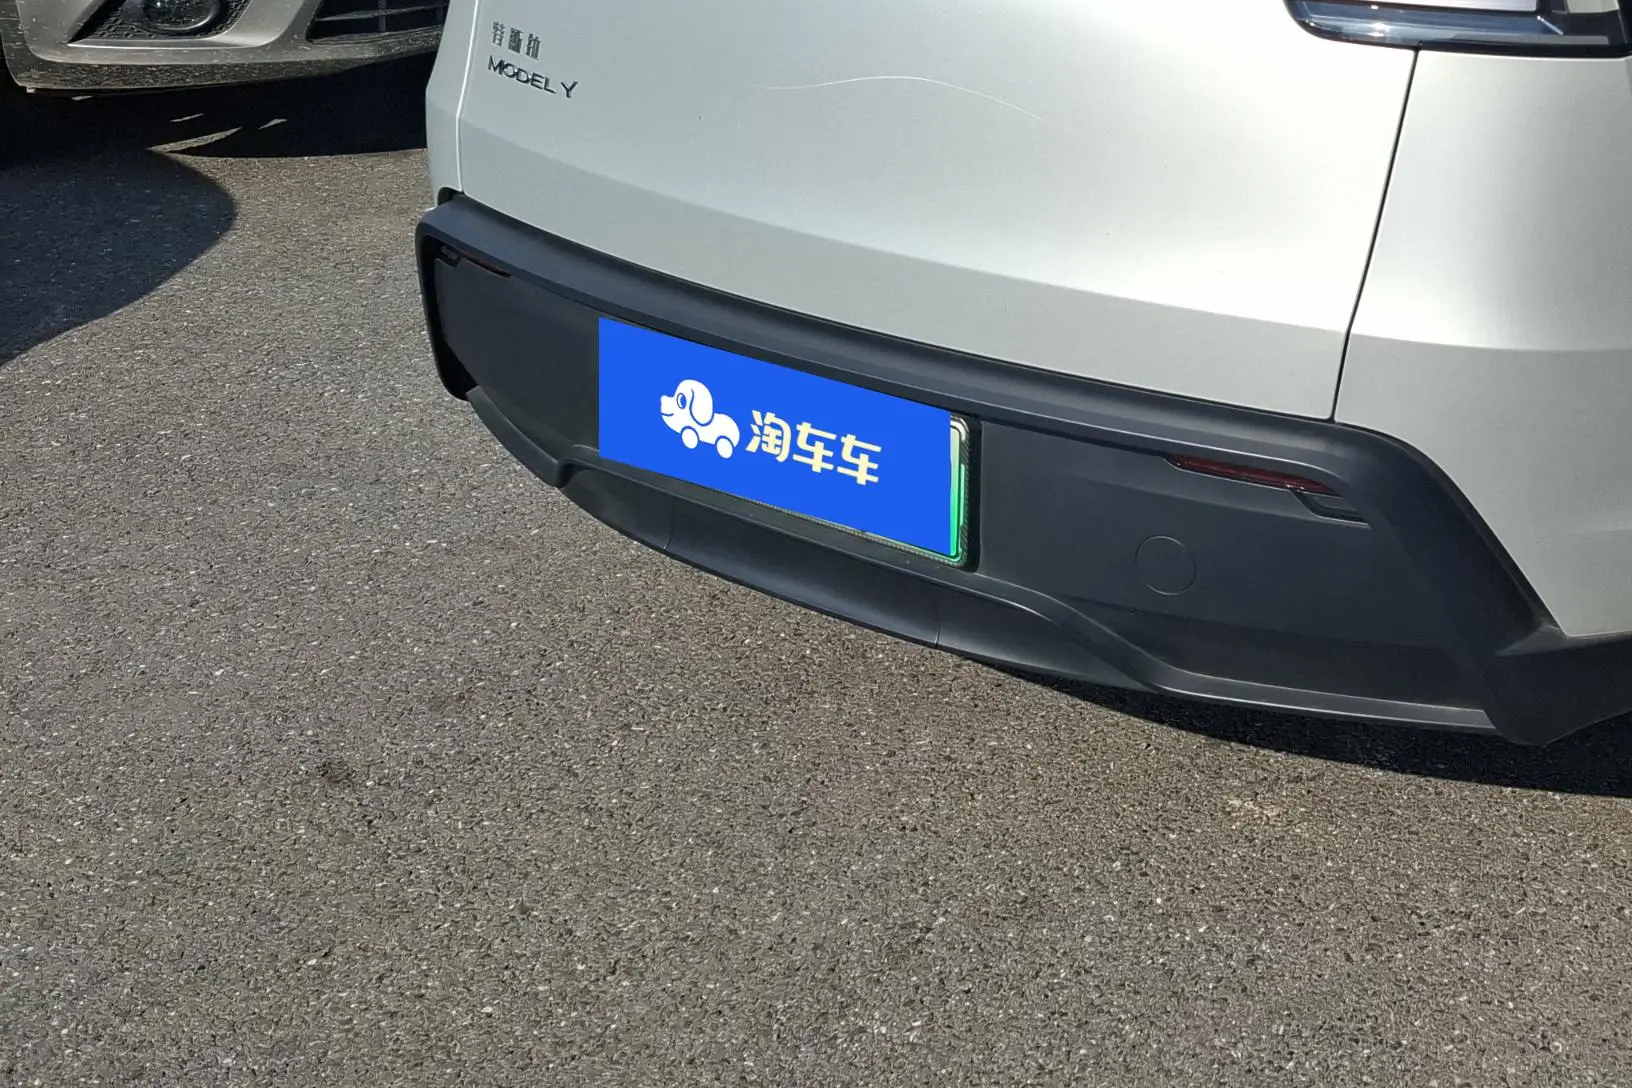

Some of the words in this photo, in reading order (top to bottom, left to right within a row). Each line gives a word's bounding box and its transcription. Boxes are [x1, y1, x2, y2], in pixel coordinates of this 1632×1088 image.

[492, 21, 541, 61] 特斯拉
[488, 55, 557, 94] MODEL
[561, 81, 578, 98] Y
